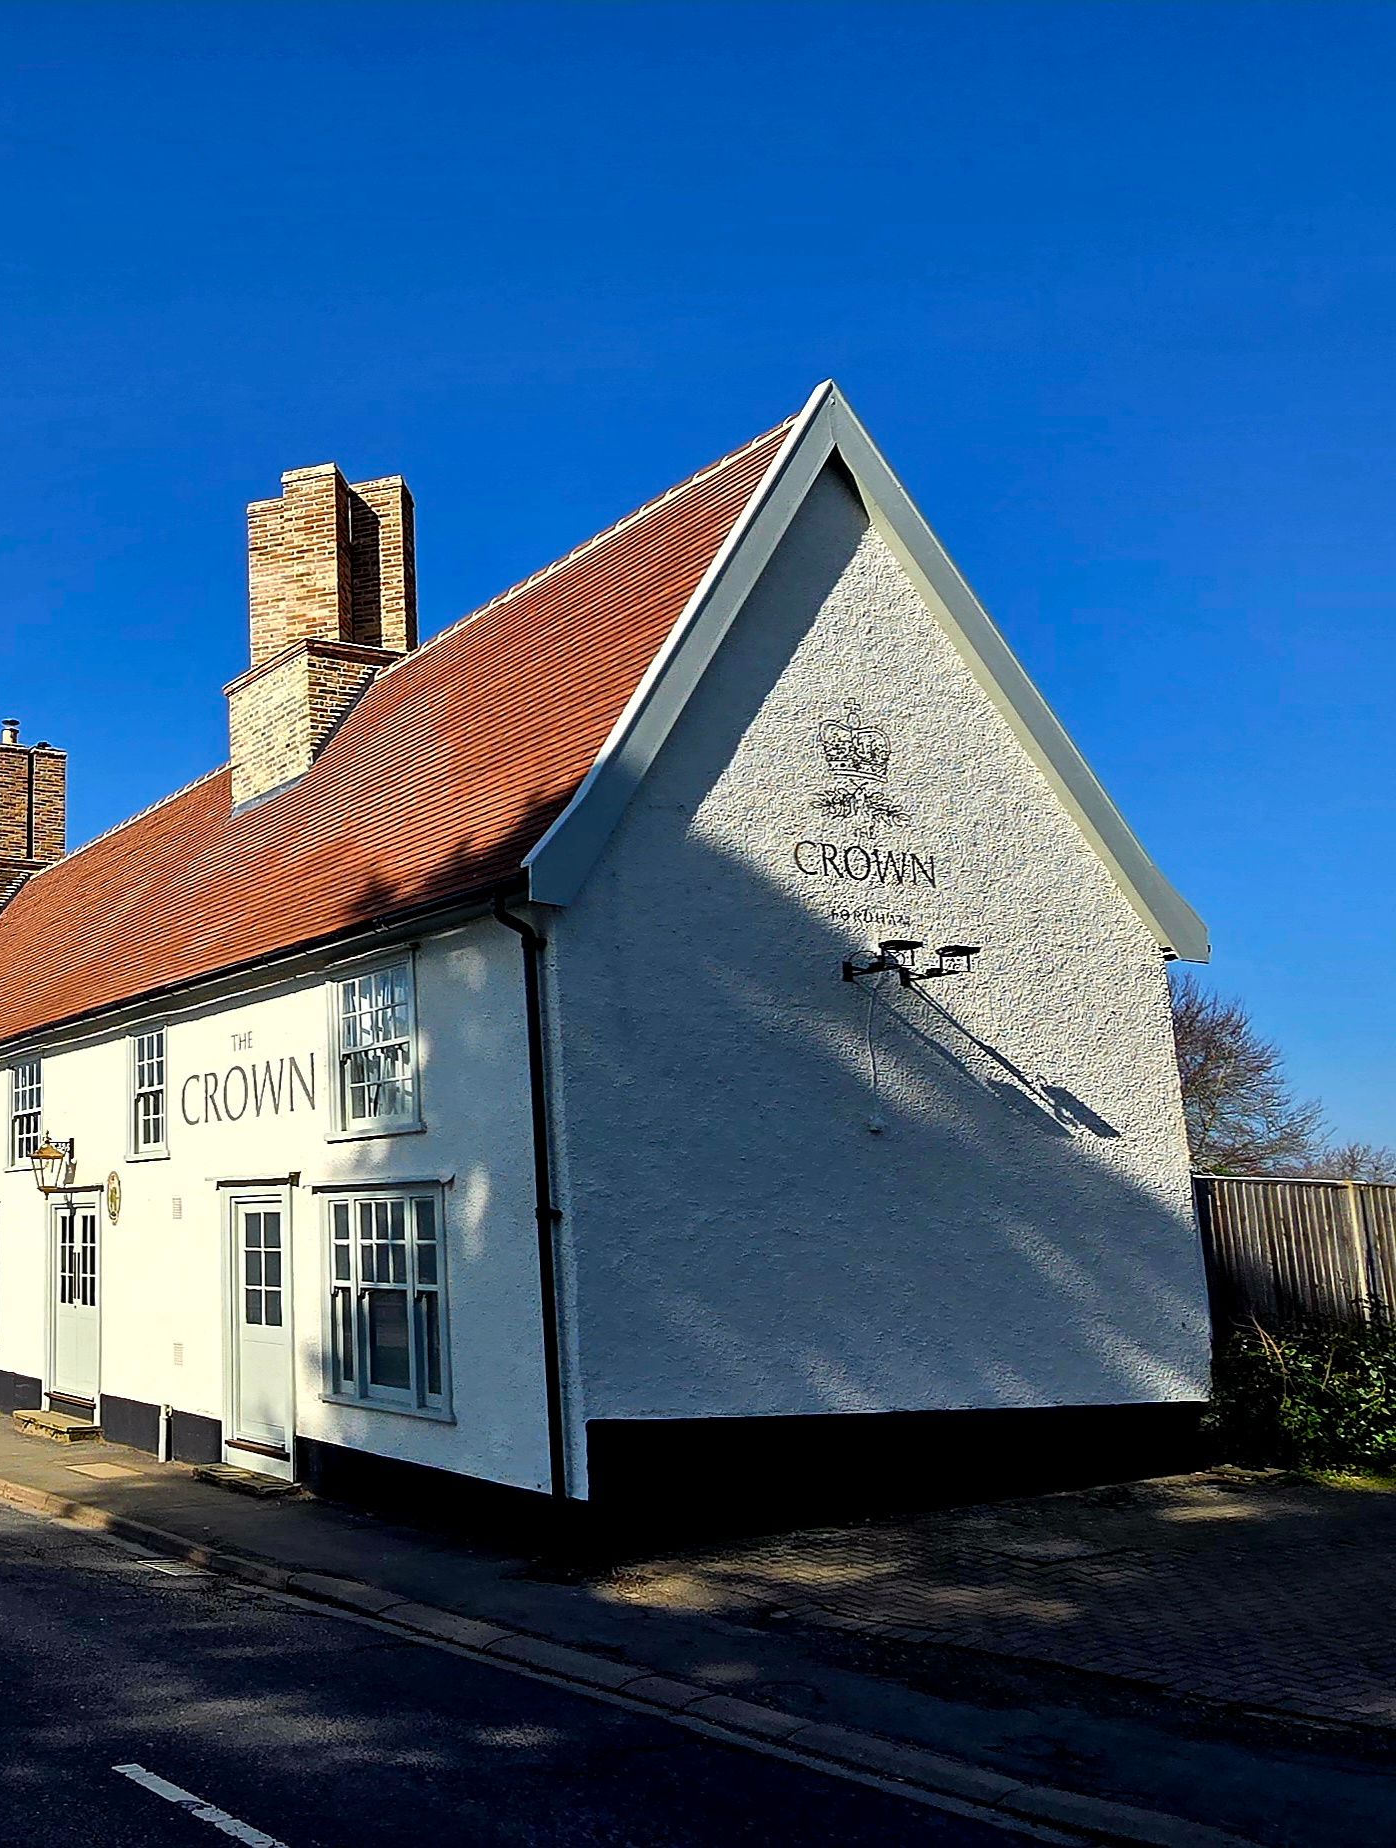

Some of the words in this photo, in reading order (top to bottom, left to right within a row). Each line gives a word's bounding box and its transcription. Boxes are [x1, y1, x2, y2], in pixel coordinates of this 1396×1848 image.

[794, 840, 937, 889] CROWN
[230, 1030, 254, 1052] THE
[181, 1052, 316, 1126] CROWN
